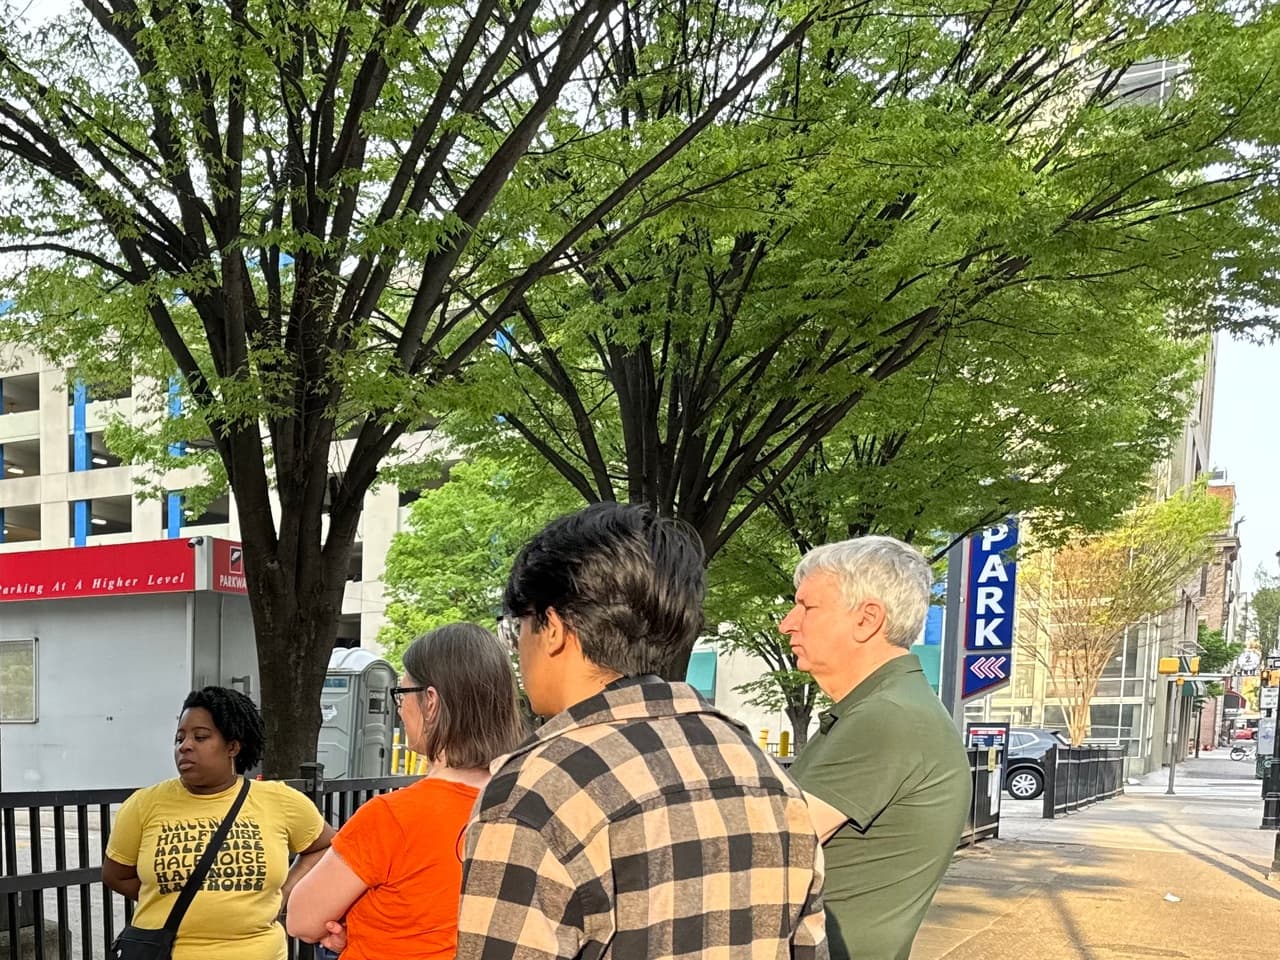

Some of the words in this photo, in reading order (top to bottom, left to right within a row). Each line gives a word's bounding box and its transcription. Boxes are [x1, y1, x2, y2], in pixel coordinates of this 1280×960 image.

[51, 581, 67, 592] At
[74, 579, 83, 590] A
[91, 577, 138, 591] Higher
[147, 572, 185, 585] Level
[975, 524, 1009, 647] PARK
